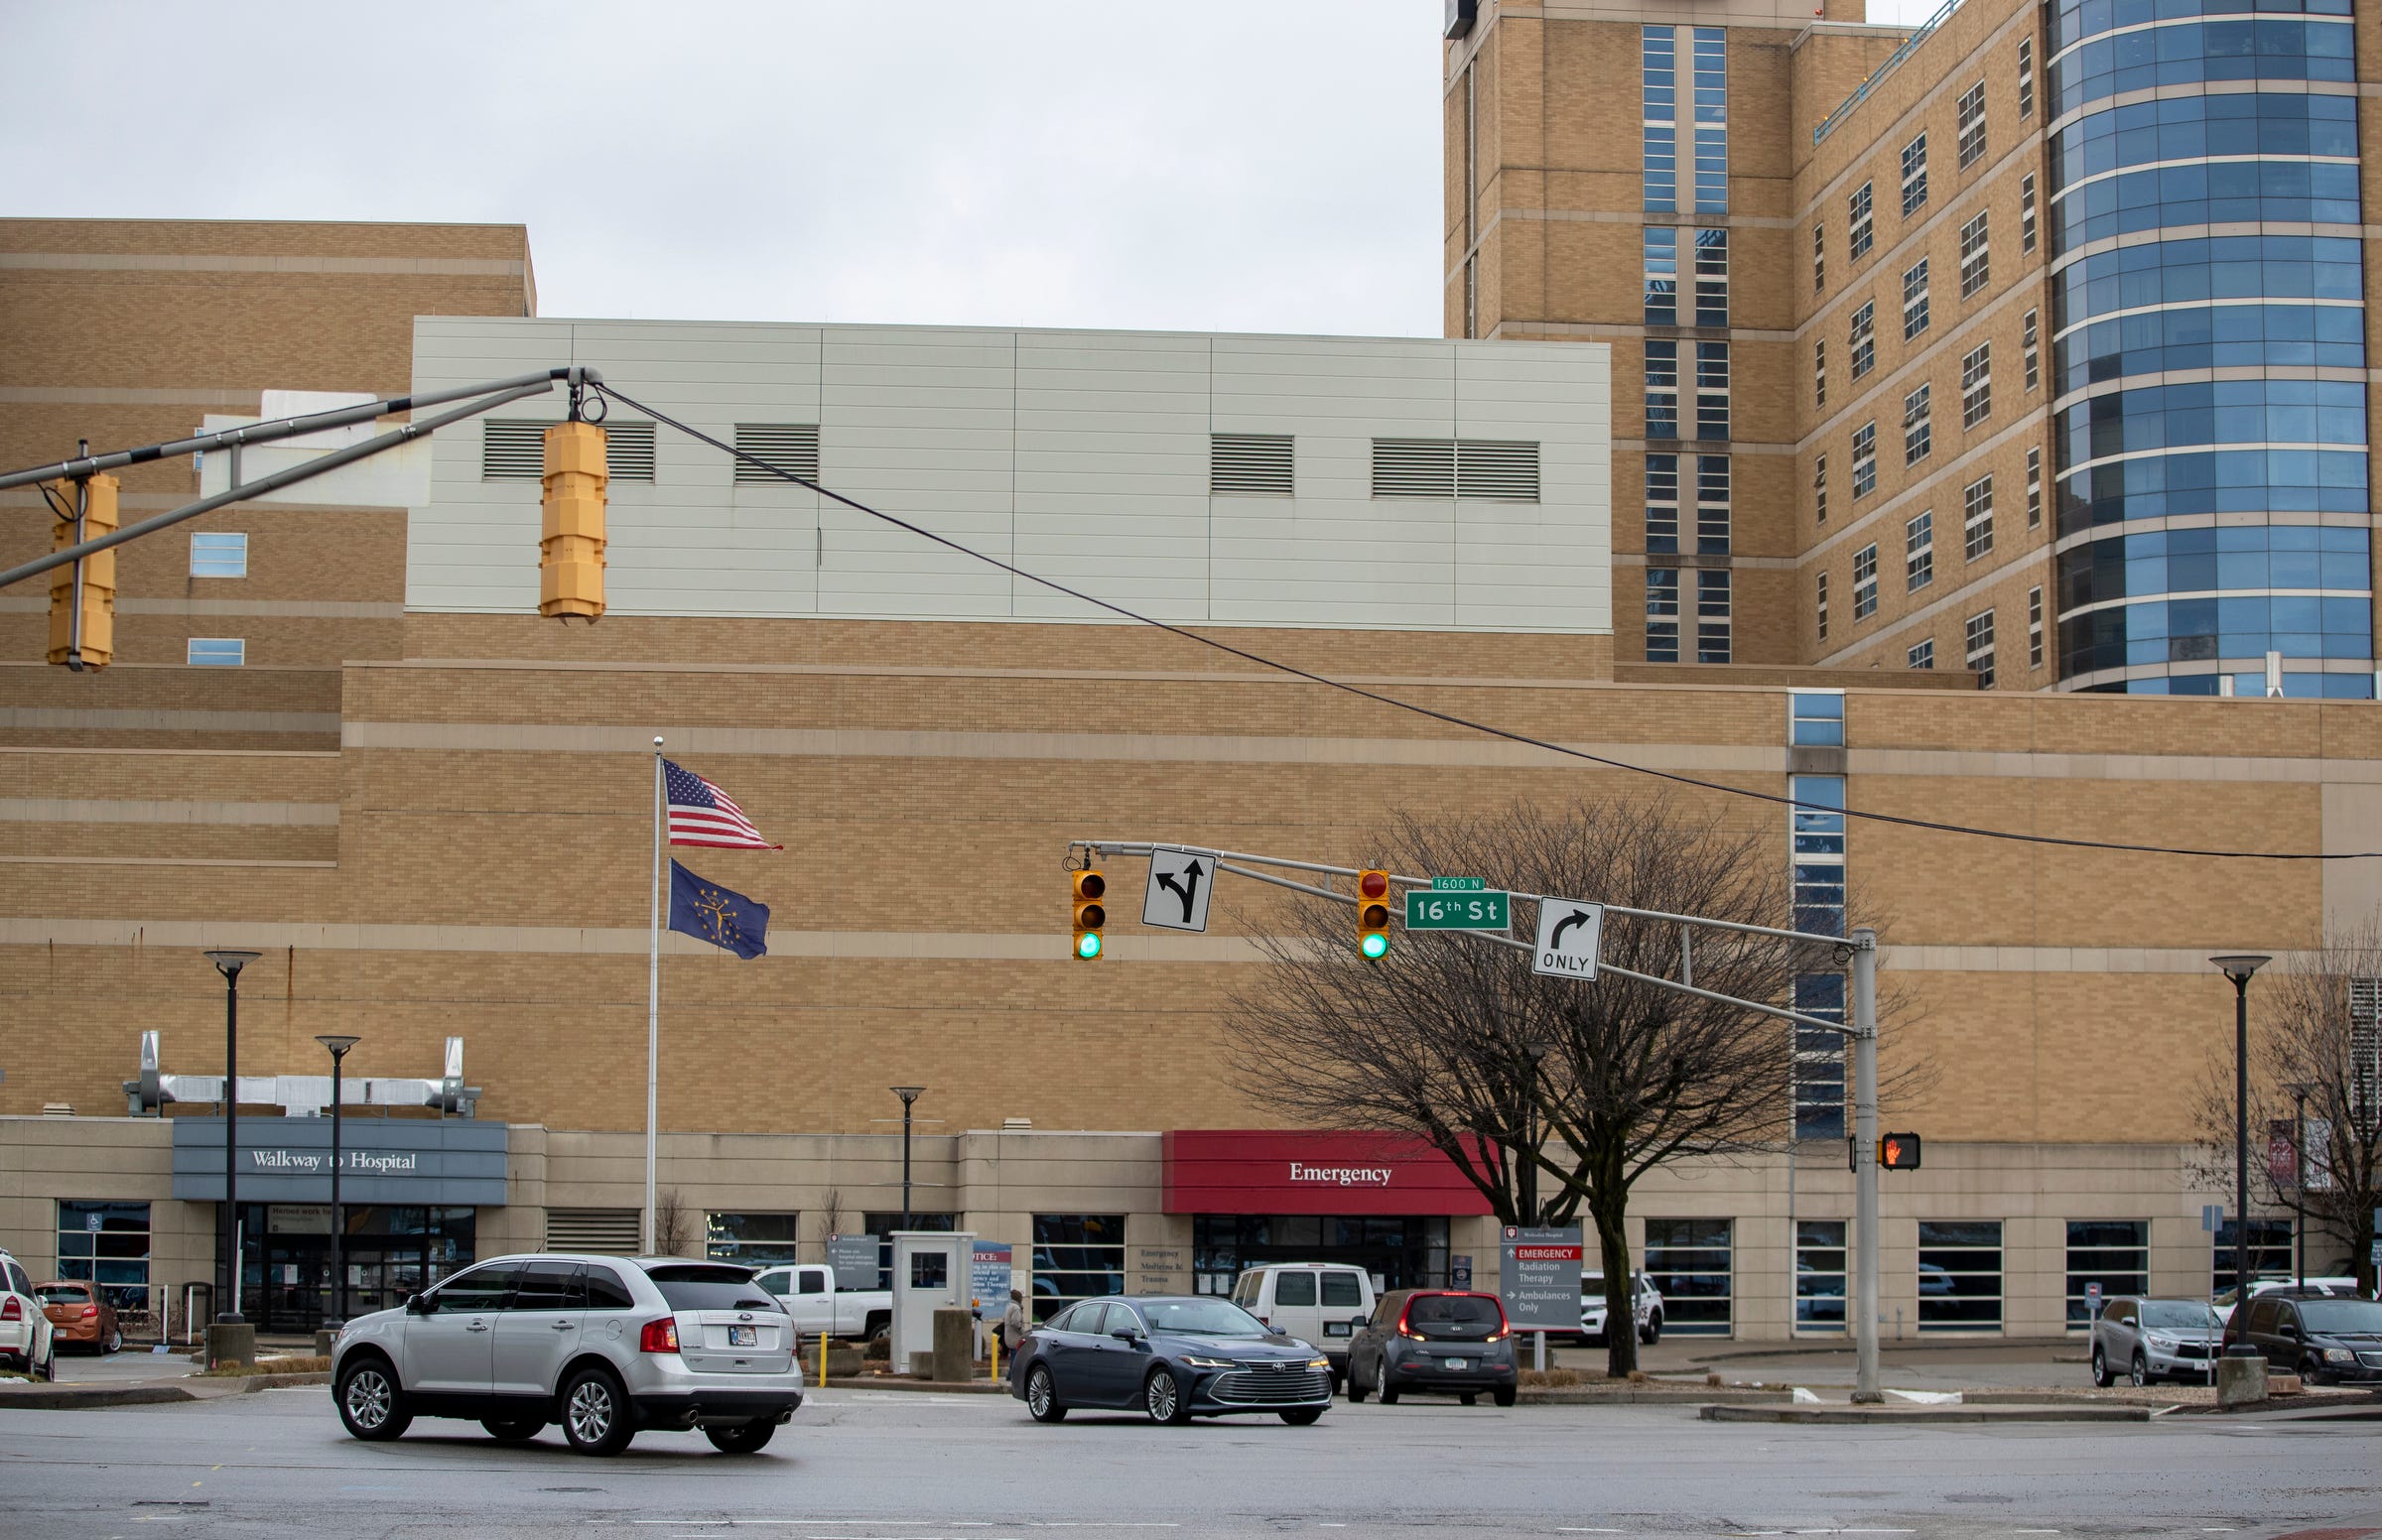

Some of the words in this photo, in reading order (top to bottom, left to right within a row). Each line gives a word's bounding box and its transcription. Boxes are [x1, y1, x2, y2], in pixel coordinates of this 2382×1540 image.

[1437, 879, 1466, 889] 1600
[1472, 879, 1480, 889] N
[1417, 901, 1462, 920] 16th
[1468, 901, 1498, 920] St
[1543, 953, 1589, 971] ONLY
[252, 1150, 322, 1171] Walkway
[350, 1152, 416, 1173] Hospital
[1289, 1162, 1392, 1186] Emergency
[301, 1207, 321, 1216] work
[1140, 1249, 1179, 1258] Emergency
[1519, 1248, 1573, 1258] EMERGENCY
[1519, 1262, 1560, 1271] Radiation
[1519, 1274, 1554, 1284] Therapy
[1519, 1291, 1571, 1300] Ambulances
[1519, 1303, 1539, 1314] Only
